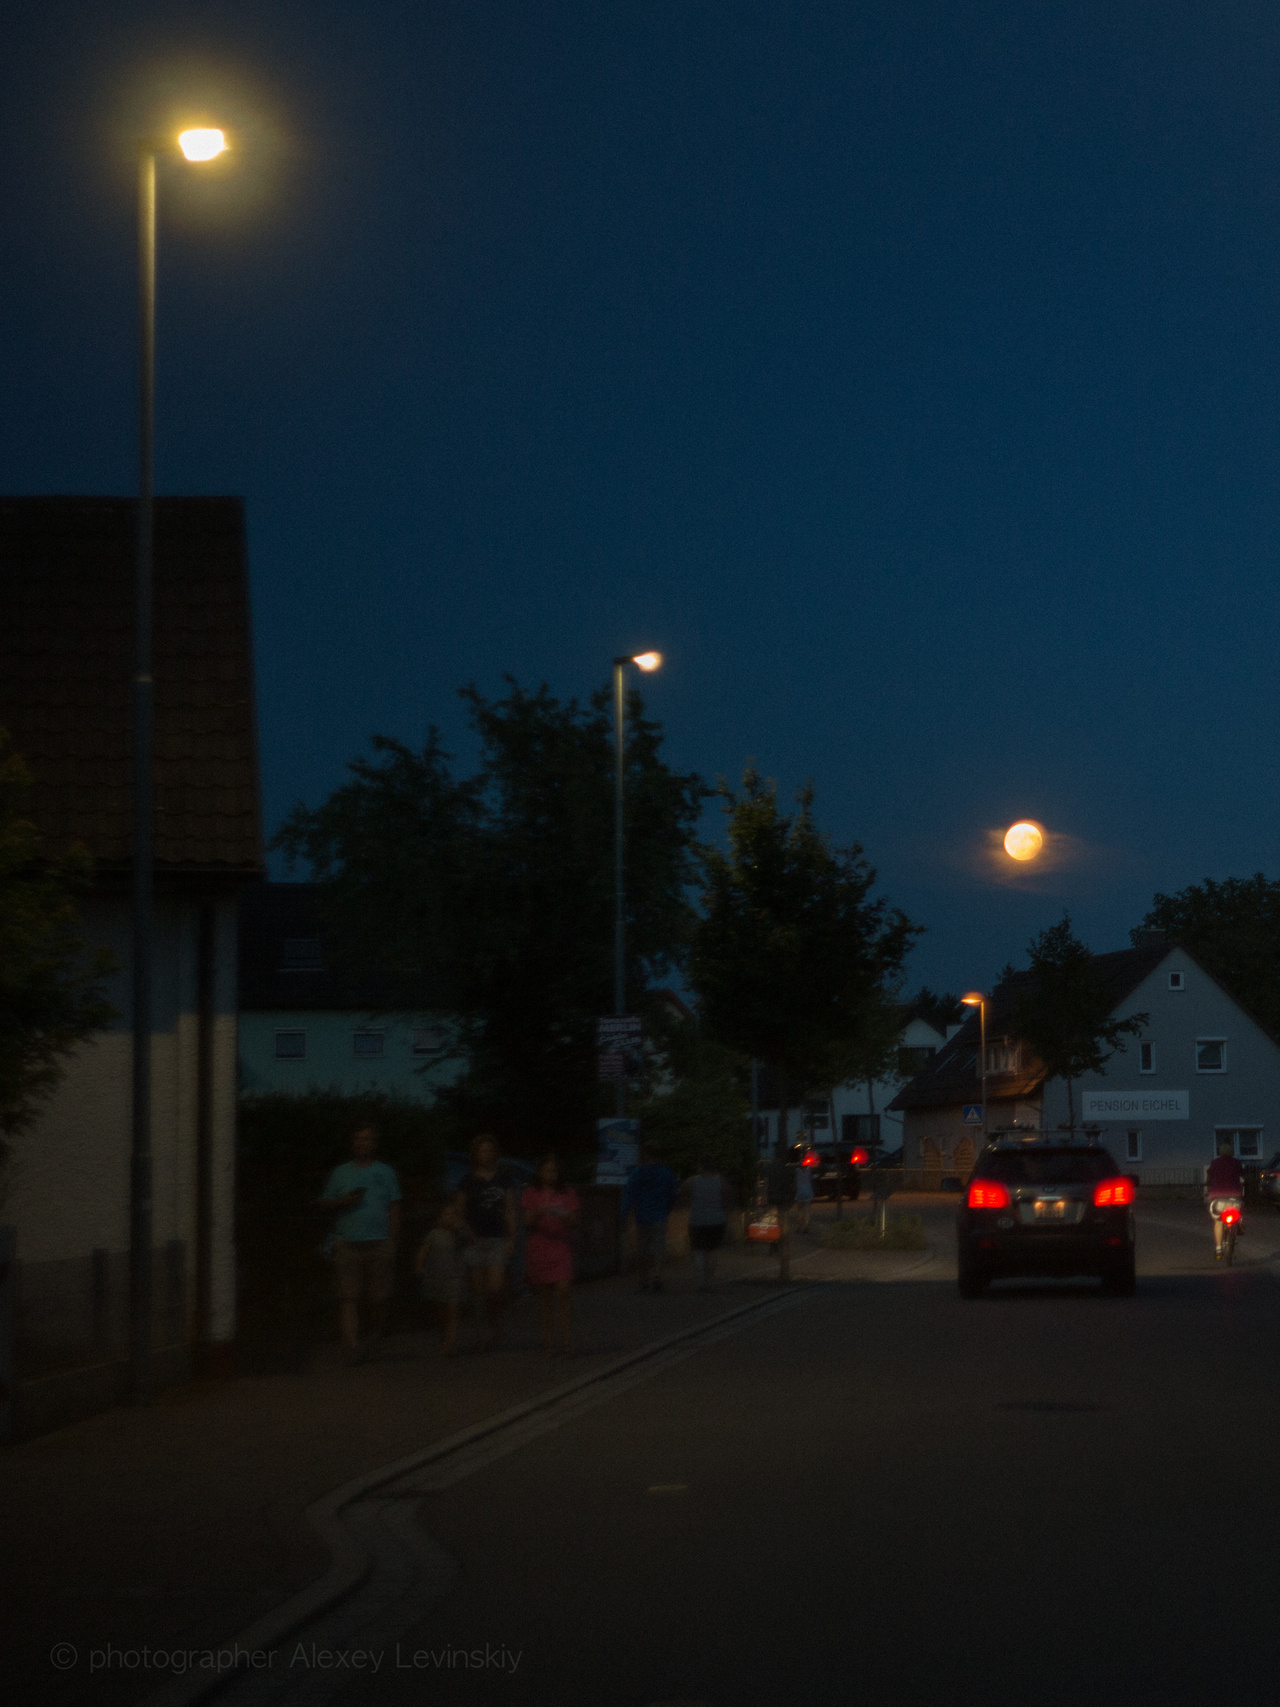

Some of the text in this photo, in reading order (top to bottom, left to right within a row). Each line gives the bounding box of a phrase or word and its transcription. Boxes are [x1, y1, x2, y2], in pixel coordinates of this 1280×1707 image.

[598, 1023, 642, 1032] MERLIN
[1090, 1099, 1181, 1111] PENSION EICHEL
